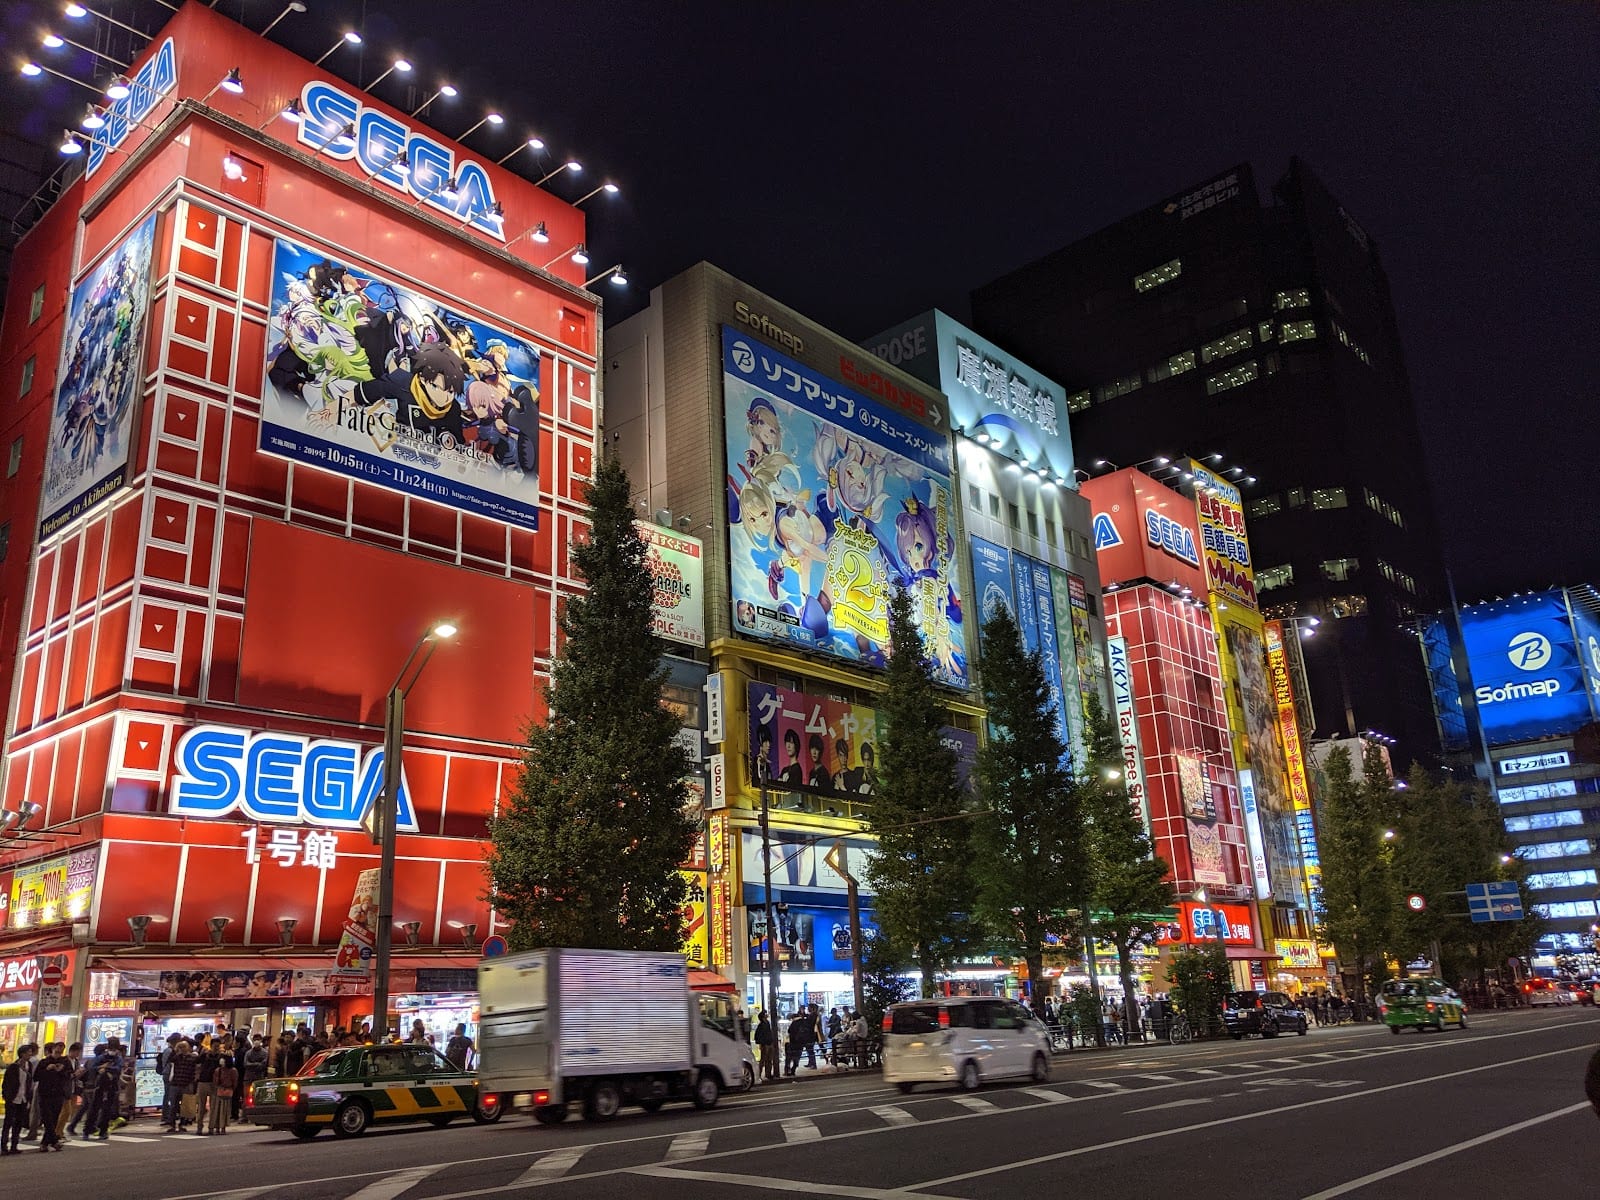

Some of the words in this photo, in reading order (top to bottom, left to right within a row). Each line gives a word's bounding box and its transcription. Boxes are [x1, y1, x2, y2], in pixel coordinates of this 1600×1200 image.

[86, 36, 178, 180] SEGA
[298, 80, 506, 242] SEGA
[734, 300, 804, 354] Sofmap
[761, 355, 855, 418] ソフマップ
[838, 355, 927, 417] ビックカメラ
[336, 395, 376, 436] Fate
[378, 410, 438, 445] Grand
[438, 427, 494, 464] Order
[43, 511, 71, 537] Welcome
[72, 504, 80, 517] to
[82, 474, 122, 510] Akihabara
[1146, 508, 1200, 568] SEGA
[1202, 523, 1250, 566] 高額買取
[657, 575, 690, 597] APPLE
[1206, 556, 1257, 603] Mulan
[843, 608, 881, 636] ANNIVERSARY
[1054, 575, 1079, 703] メロンブックス
[1475, 679, 1560, 704] Sofmap
[1119, 708, 1138, 780] Tax-free
[169, 724, 420, 833] SEGA
[714, 764, 723, 798] GPS
[241, 828, 339, 870] 1号館
[713, 884, 724, 948] ステーキとハンバーグ
[1411, 898, 1422, 907] 50
[835, 934, 849, 944] 437
[1231, 924, 1250, 940] 3号館
